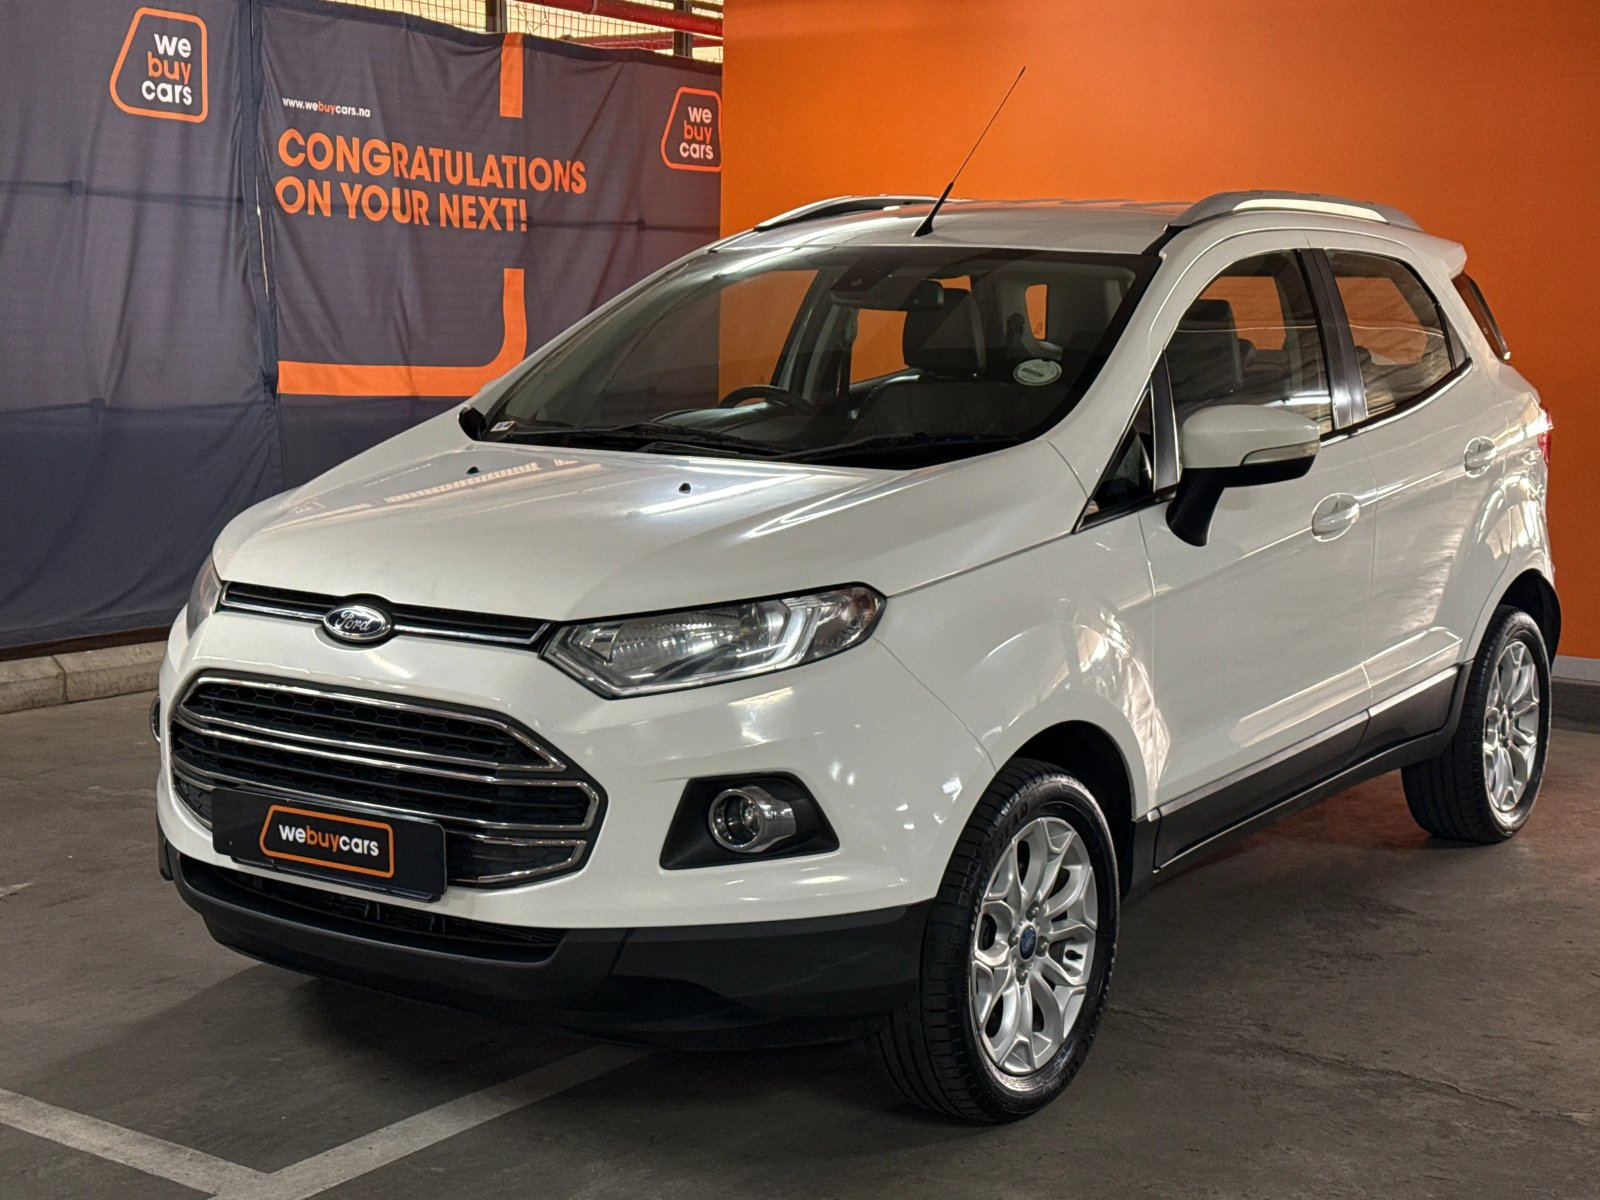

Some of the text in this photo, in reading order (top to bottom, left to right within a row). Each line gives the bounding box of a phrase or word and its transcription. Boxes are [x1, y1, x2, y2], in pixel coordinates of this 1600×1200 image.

[154, 33, 192, 58] we
[147, 51, 192, 84] buy
[141, 80, 192, 105] cars
[282, 97, 371, 118] www.webuycars.na
[688, 106, 712, 124] we
[684, 120, 712, 144] buy
[278, 128, 587, 194] CONGRATULATIONS
[679, 142, 714, 160] cars
[275, 176, 527, 232] ON YOUR NEXT!
[334, 609, 371, 631] Ford
[278, 823, 380, 857] webuycars
